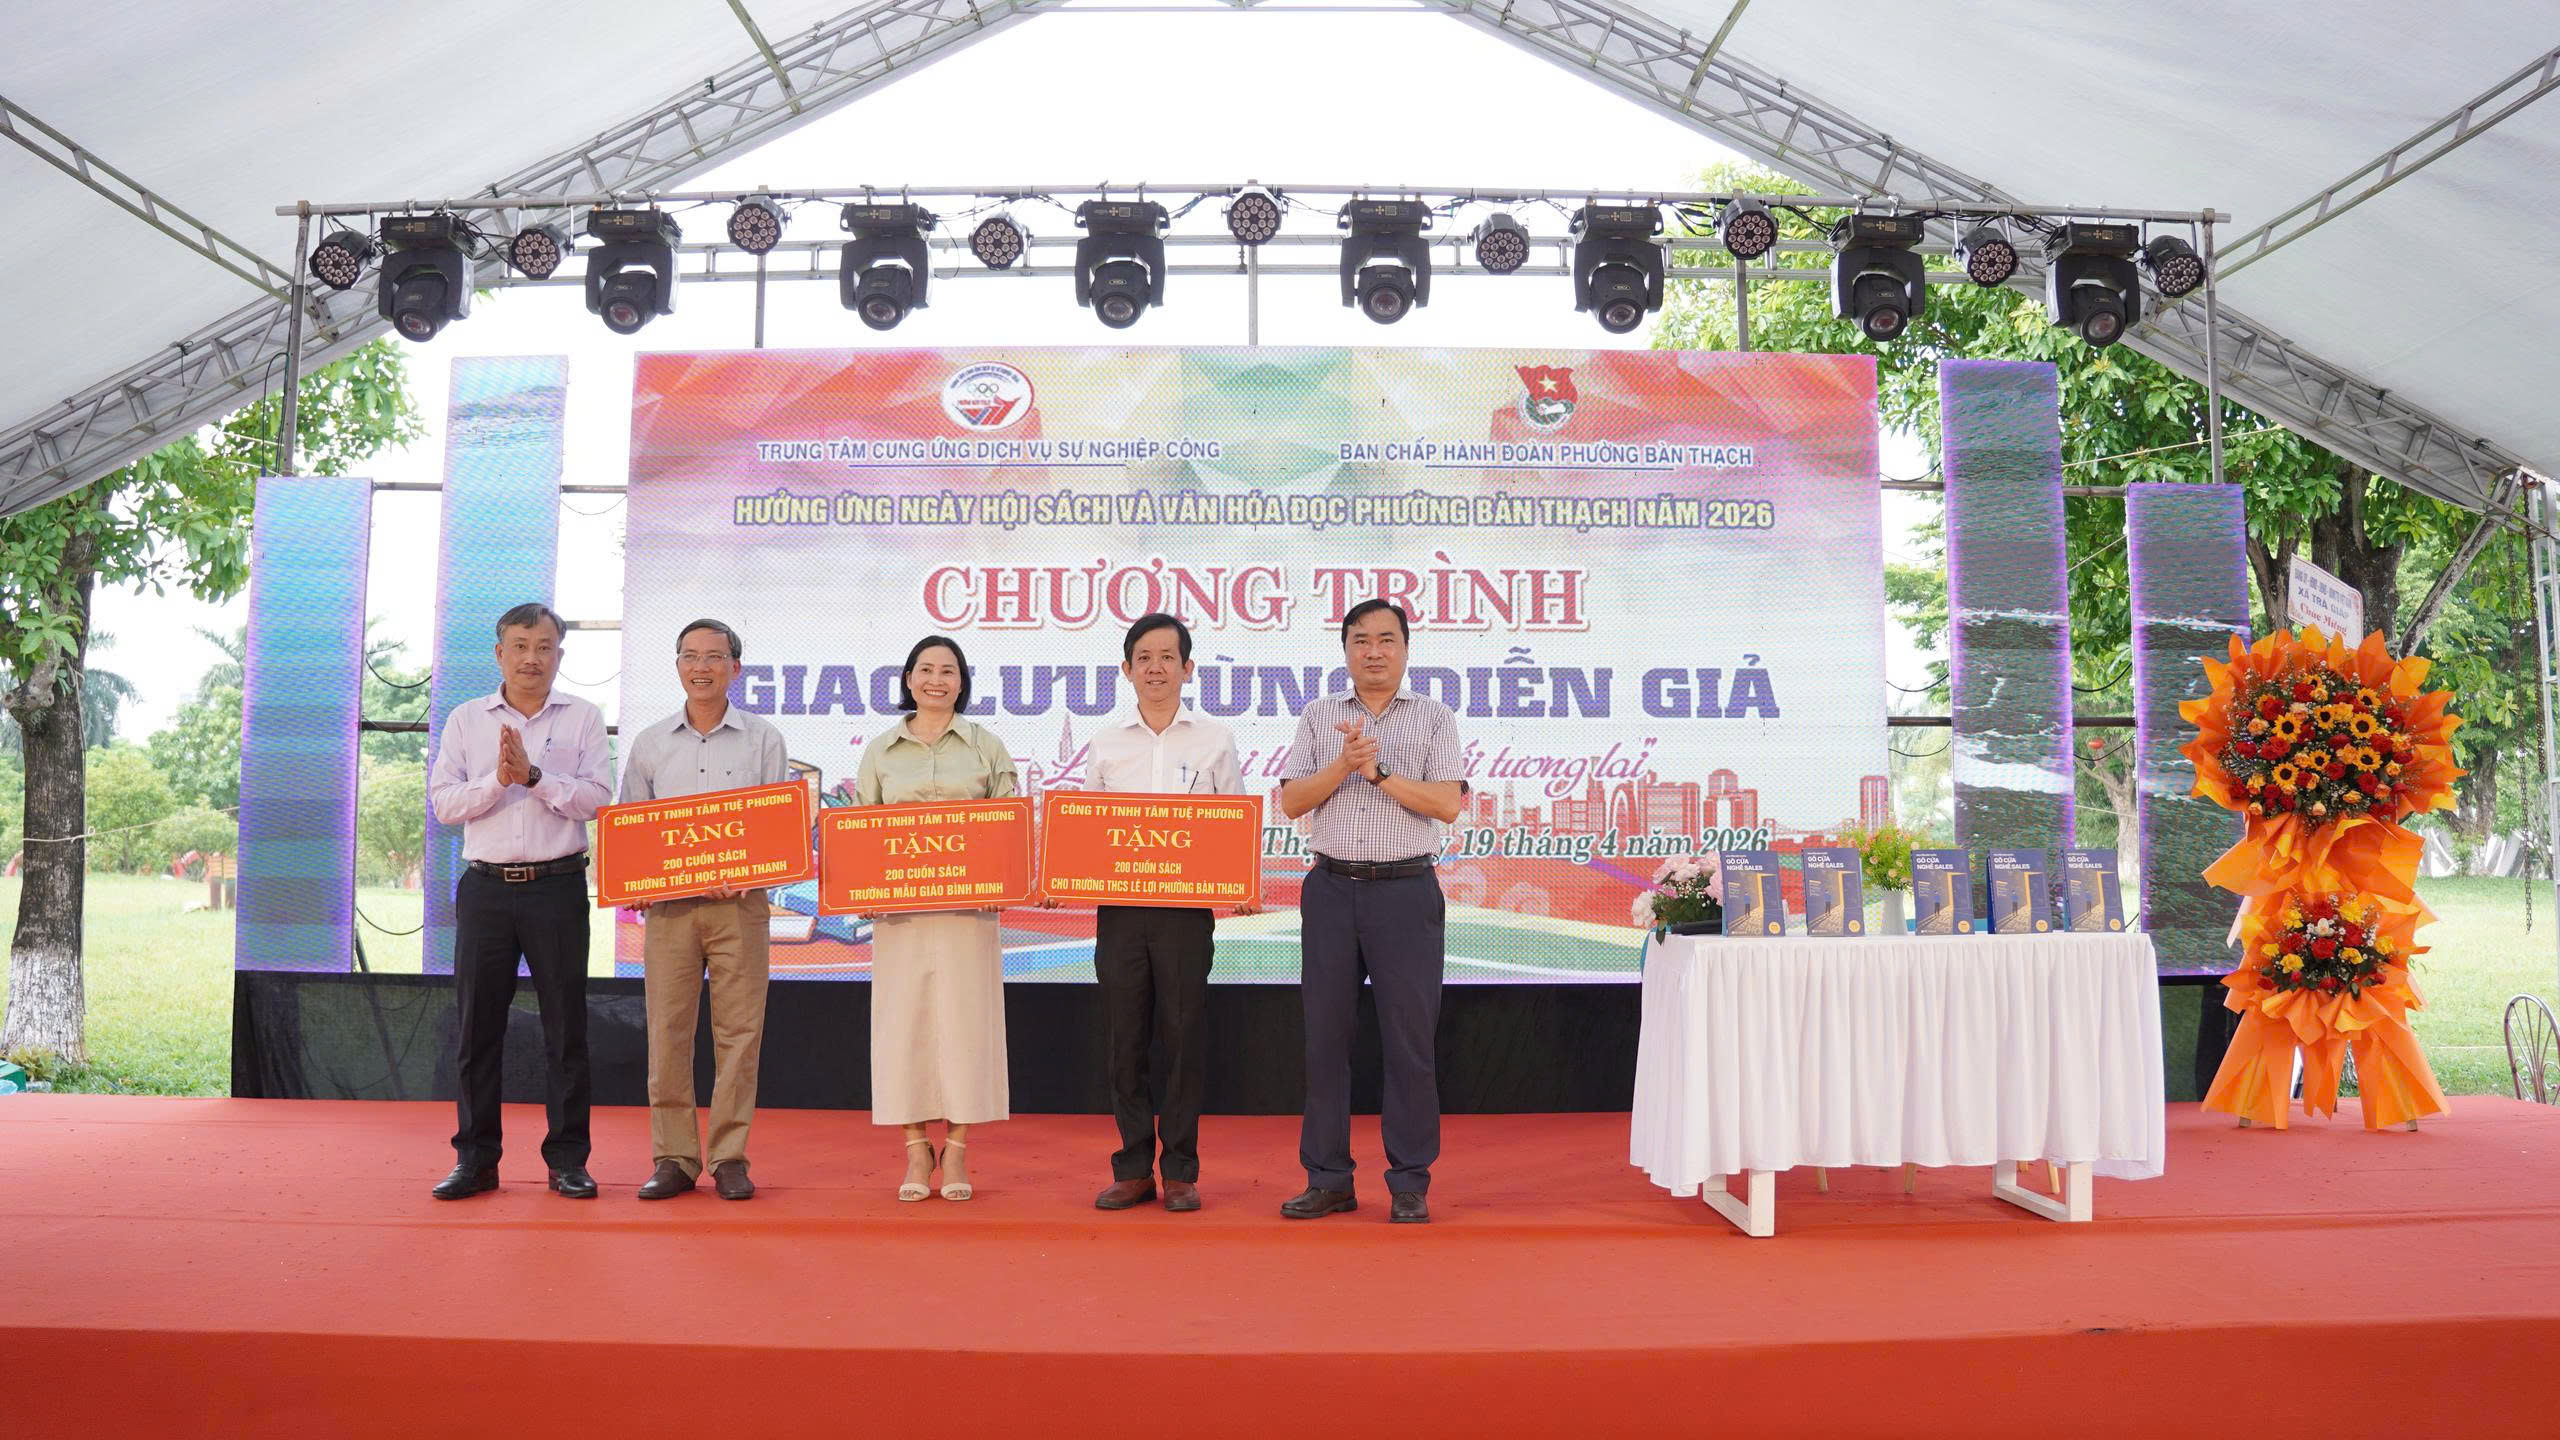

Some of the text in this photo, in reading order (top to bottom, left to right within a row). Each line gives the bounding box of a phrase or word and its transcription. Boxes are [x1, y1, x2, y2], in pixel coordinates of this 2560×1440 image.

[758, 437, 1220, 462] TRUNG TÂM CUNG ỨNG DỊCH VỤ SỰ NGHIỆP CÔNG
[1340, 437, 1751, 469] BAN CHẤP HÀNH ĐOÀN PHƯỜNG BÀN THẠCH
[735, 488, 1774, 533] HƯỞNG ỨNG NGÀY HỘI SÁCH VÀ VĂN HÓA ĐỌC PHƯỜNG BÀN THẠCH NĂM 2026
[922, 552, 1585, 626] CHƯƠNG TRÌNH
[1642, 654, 1780, 719] GIẢ
[614, 793, 792, 827] CÔNG TY TNHH TÂM TUỆ PHƯƠNG
[837, 809, 1016, 830] CÔNG TY TNHH TÂM TUỆ PHƯƠNG
[1061, 802, 1244, 820] CÔNG TY TNHH TÂM TUỆ PHƯƠNG
[661, 820, 745, 848] TẶNG
[884, 832, 967, 859] TẶNG
[1107, 823, 1193, 852] TẶNG
[1462, 828, 1496, 857] 19
[1503, 827, 1593, 862] tháng
[1600, 829, 1617, 856] 4
[1625, 828, 1692, 856] năm
[1702, 828, 1769, 854] 2026
[663, 848, 747, 871] 200 CUỐN SÁCH
[885, 863, 966, 881] 200 CUỐN SÁCH
[1114, 858, 1182, 874] 200 CUỐN SÁCH
[624, 860, 788, 893] TRƯỜNG TIỂU HỌC PHAN THANH
[1051, 876, 1245, 898] CHO TRƯỜNG THCS LÊ LỢI PHƯỜNG BÀN THẠCH
[849, 881, 1004, 901] TRƯỜNG MẪU GIÁO BÌNH MINH
